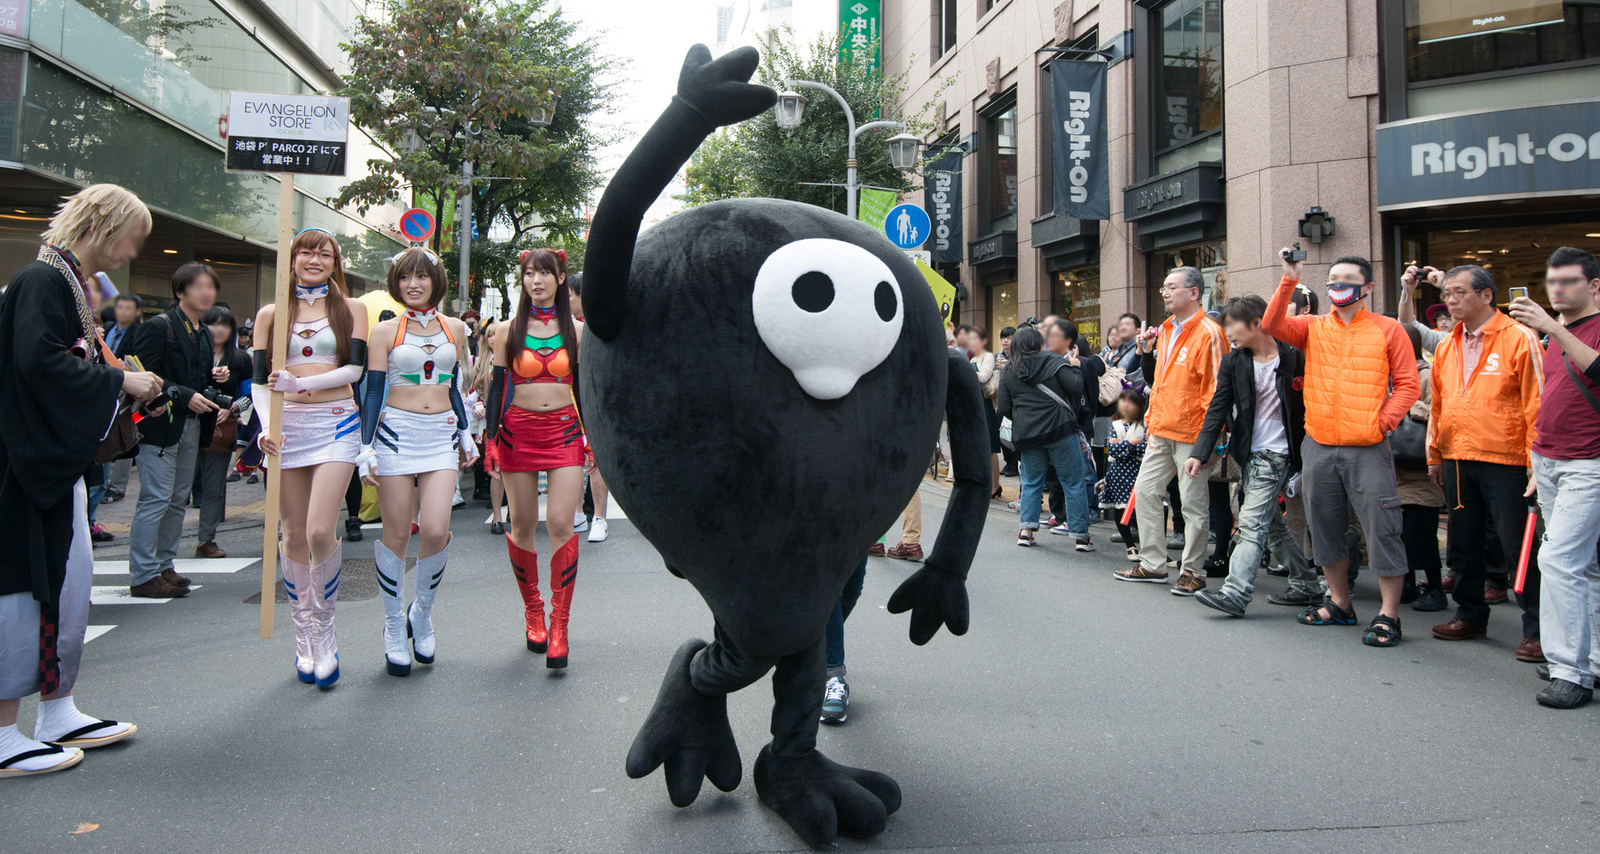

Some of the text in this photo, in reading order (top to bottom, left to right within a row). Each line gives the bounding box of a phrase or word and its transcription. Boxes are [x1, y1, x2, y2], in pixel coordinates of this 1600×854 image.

[1472, 15, 1506, 26] Right-on
[244, 101, 337, 118] EVANGELION
[269, 115, 312, 129] STORE
[235, 140, 256, 151] 池袋
[272, 143, 305, 154] PARCO
[306, 145, 318, 154] 2F
[320, 145, 340, 156] にて
[1063, 90, 1091, 203] Right-on
[931, 171, 952, 251] Right-on
[1177, 346, 1188, 362] S
[1485, 353, 1500, 372] S
